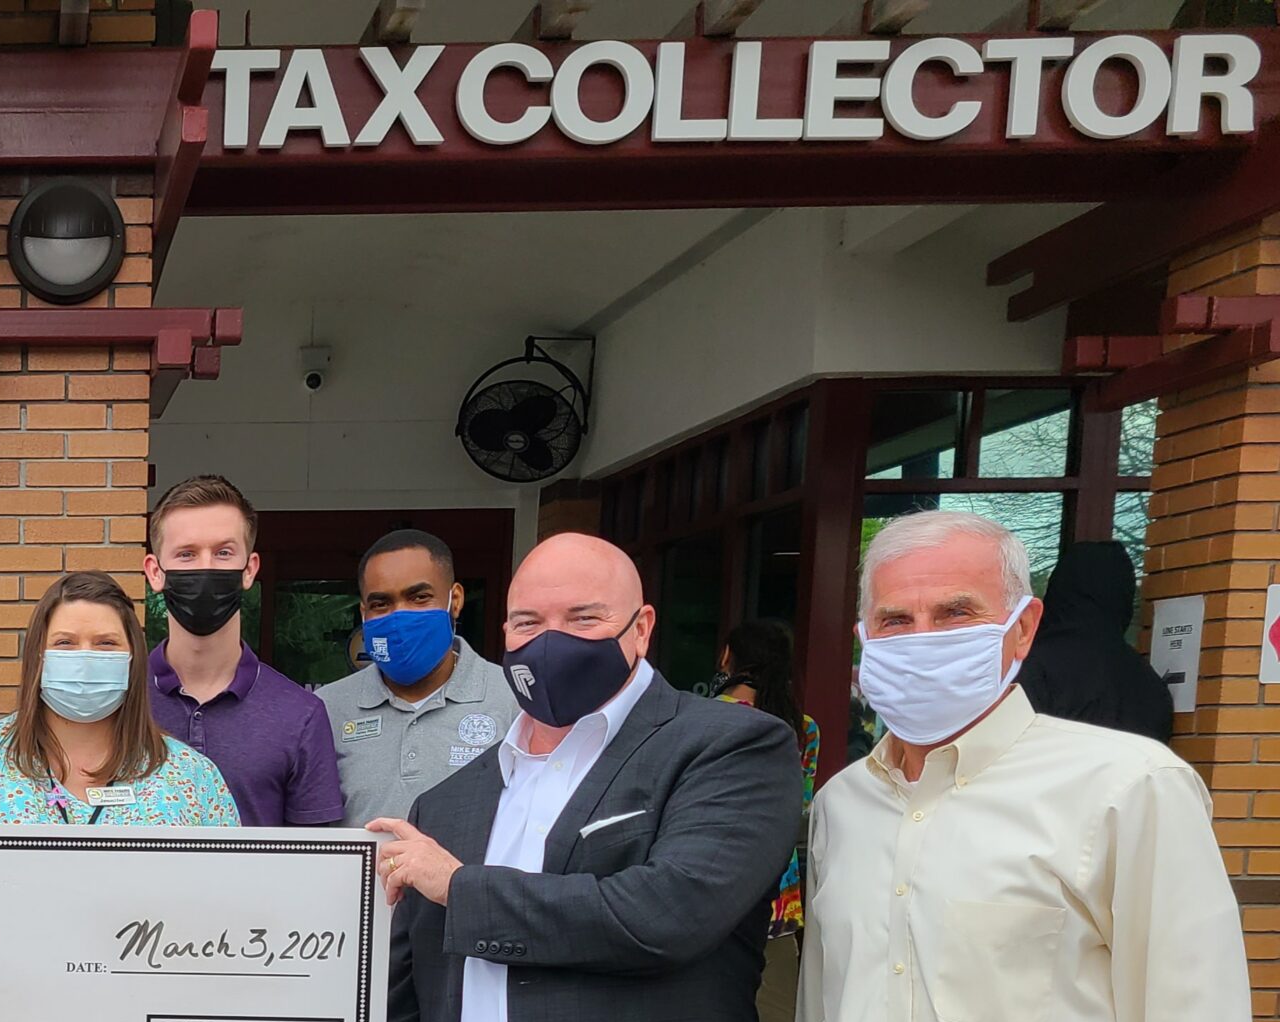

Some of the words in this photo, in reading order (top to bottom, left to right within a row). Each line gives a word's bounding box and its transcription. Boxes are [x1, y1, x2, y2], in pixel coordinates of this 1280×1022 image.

[211, 45, 445, 150] TAX
[456, 34, 1261, 145] COLLECTOR
[66, 962, 107, 973] DATE:
[115, 919, 237, 969] March
[279, 931, 346, 960] 2021
